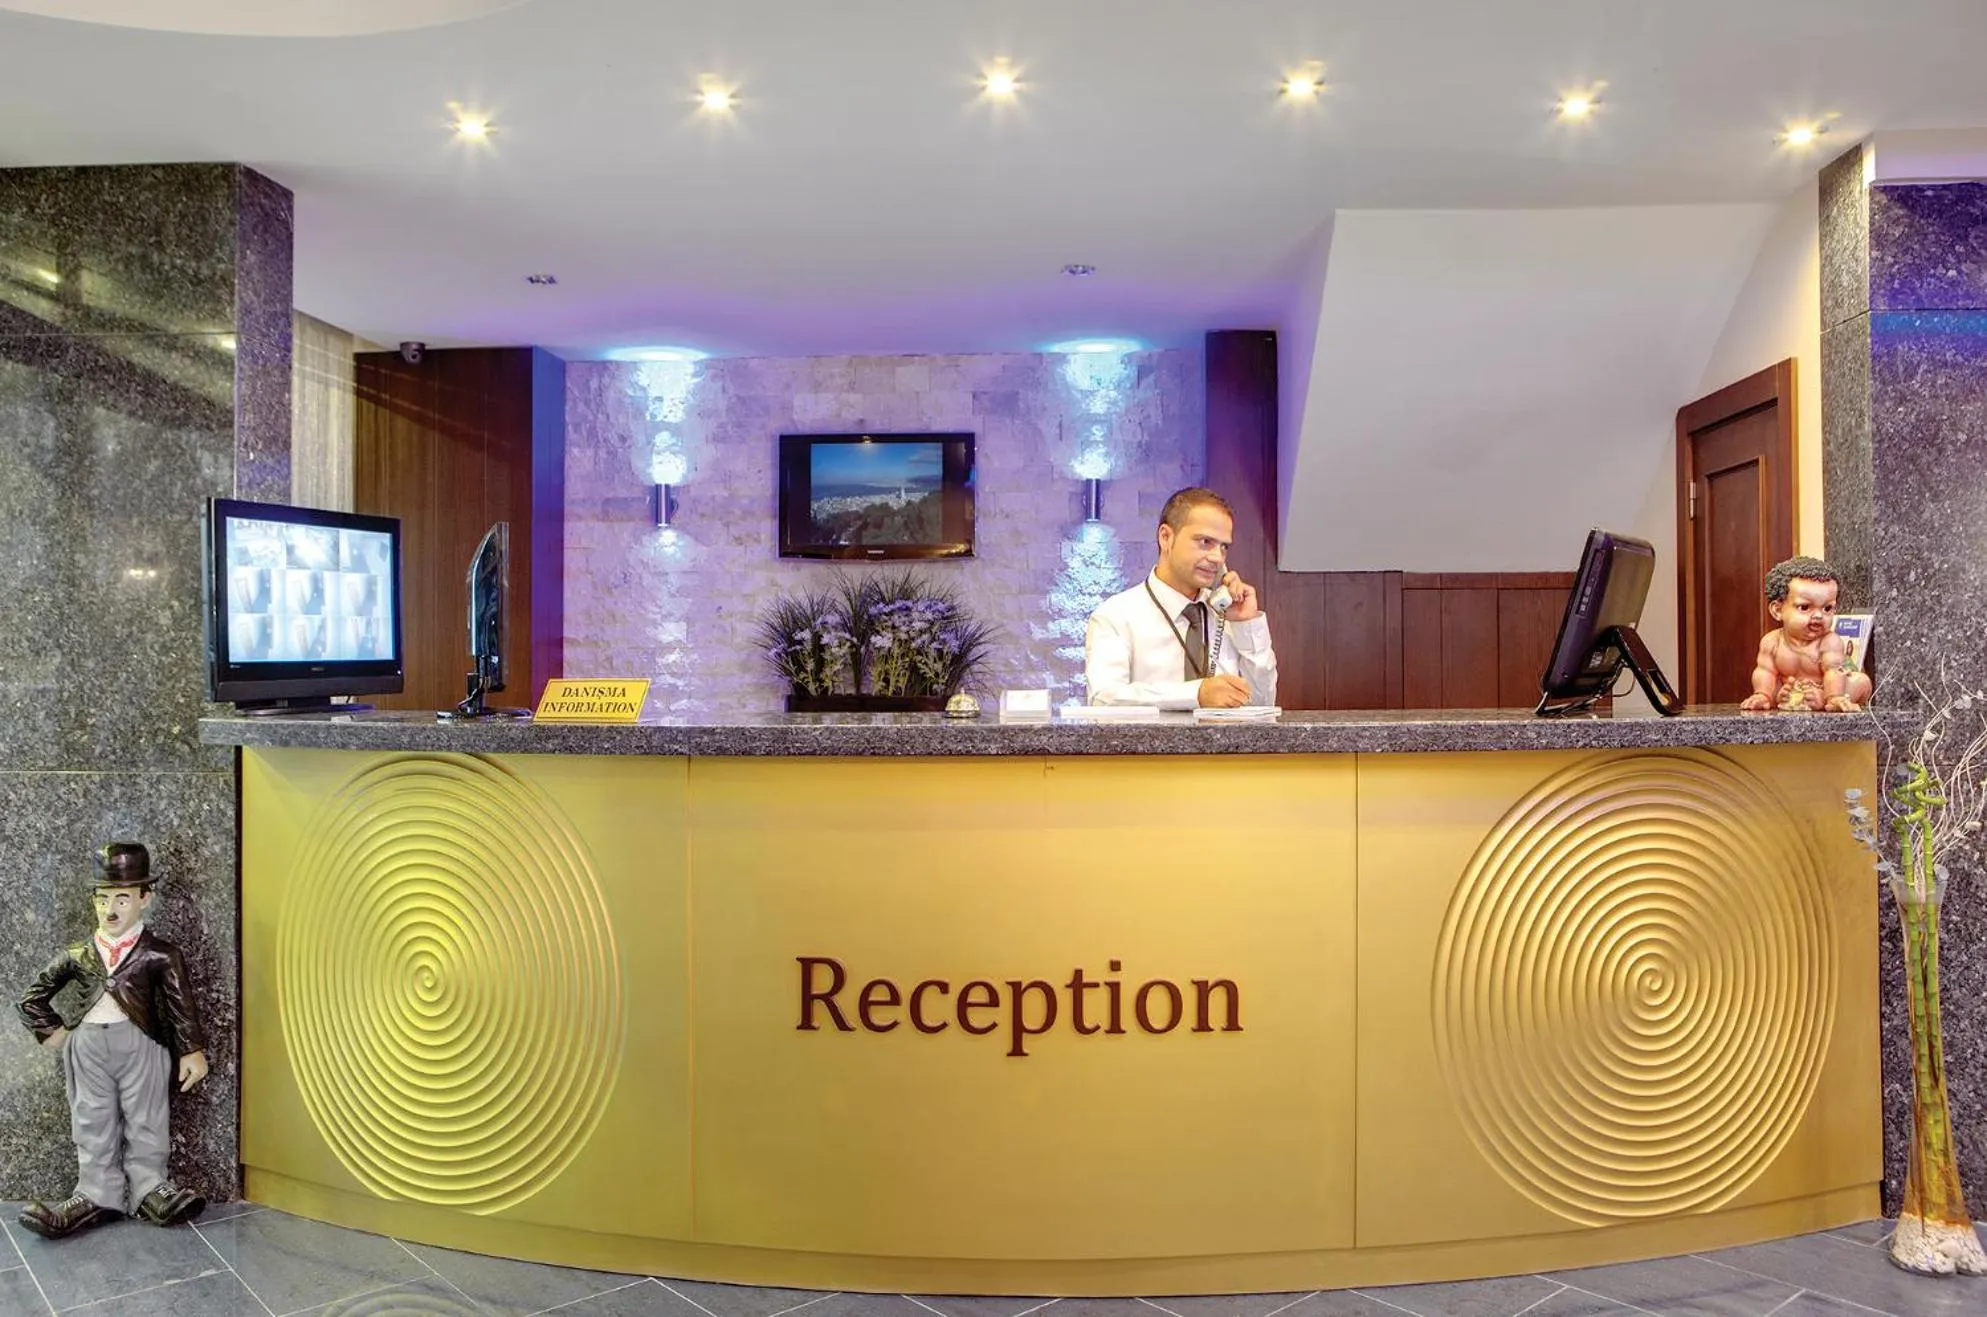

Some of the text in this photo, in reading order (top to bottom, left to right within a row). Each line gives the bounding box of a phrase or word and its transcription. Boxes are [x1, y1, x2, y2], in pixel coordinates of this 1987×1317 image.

[561, 686, 627, 700] DANIŞMA
[543, 701, 636, 713] INFORMATION
[795, 956, 1244, 1057] Reception
